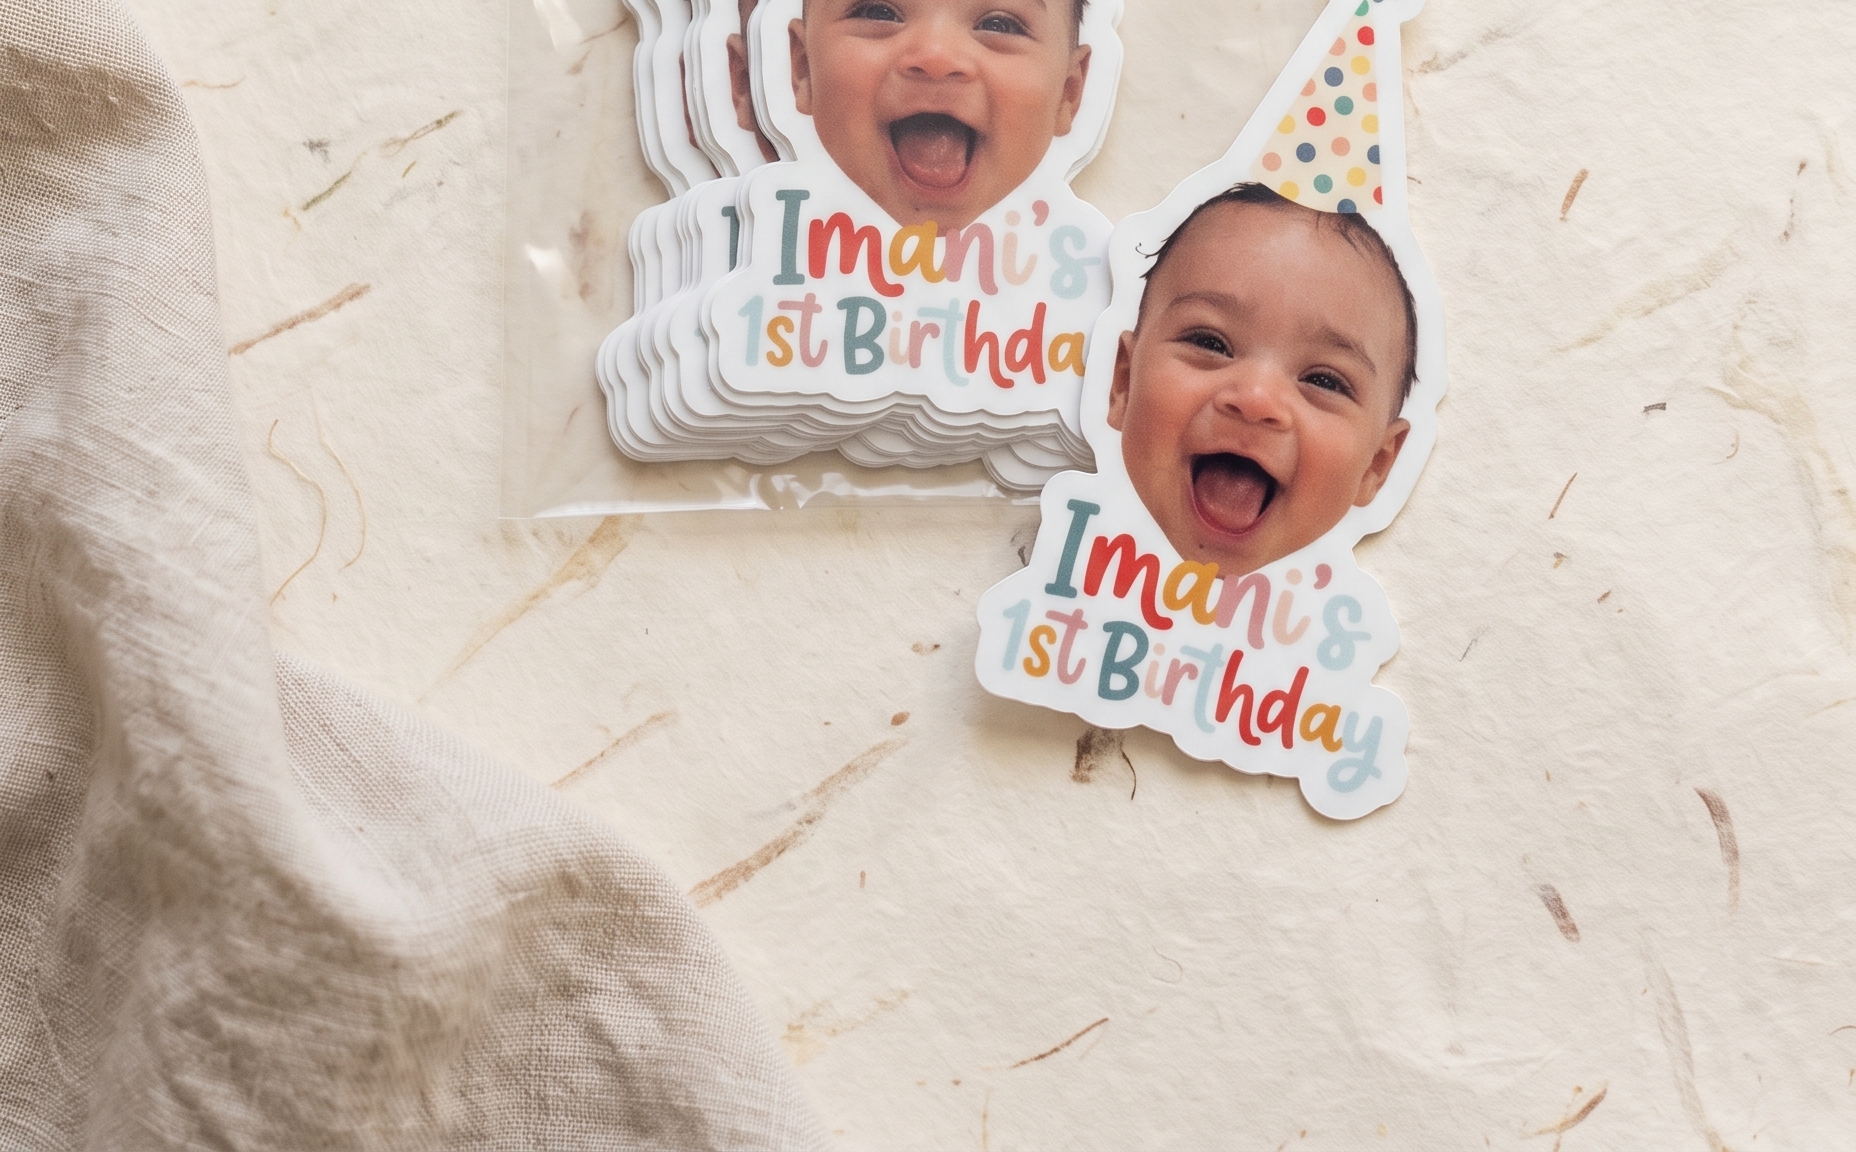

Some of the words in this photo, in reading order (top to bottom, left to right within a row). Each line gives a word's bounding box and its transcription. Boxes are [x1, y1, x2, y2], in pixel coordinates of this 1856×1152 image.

[772, 189, 1101, 299] Imani's
[737, 292, 828, 368] 1st
[836, 295, 1086, 389] Birthda
[1044, 498, 1372, 672] Imani's
[1001, 598, 1089, 685] 1st
[1097, 620, 1384, 794] Birthday
